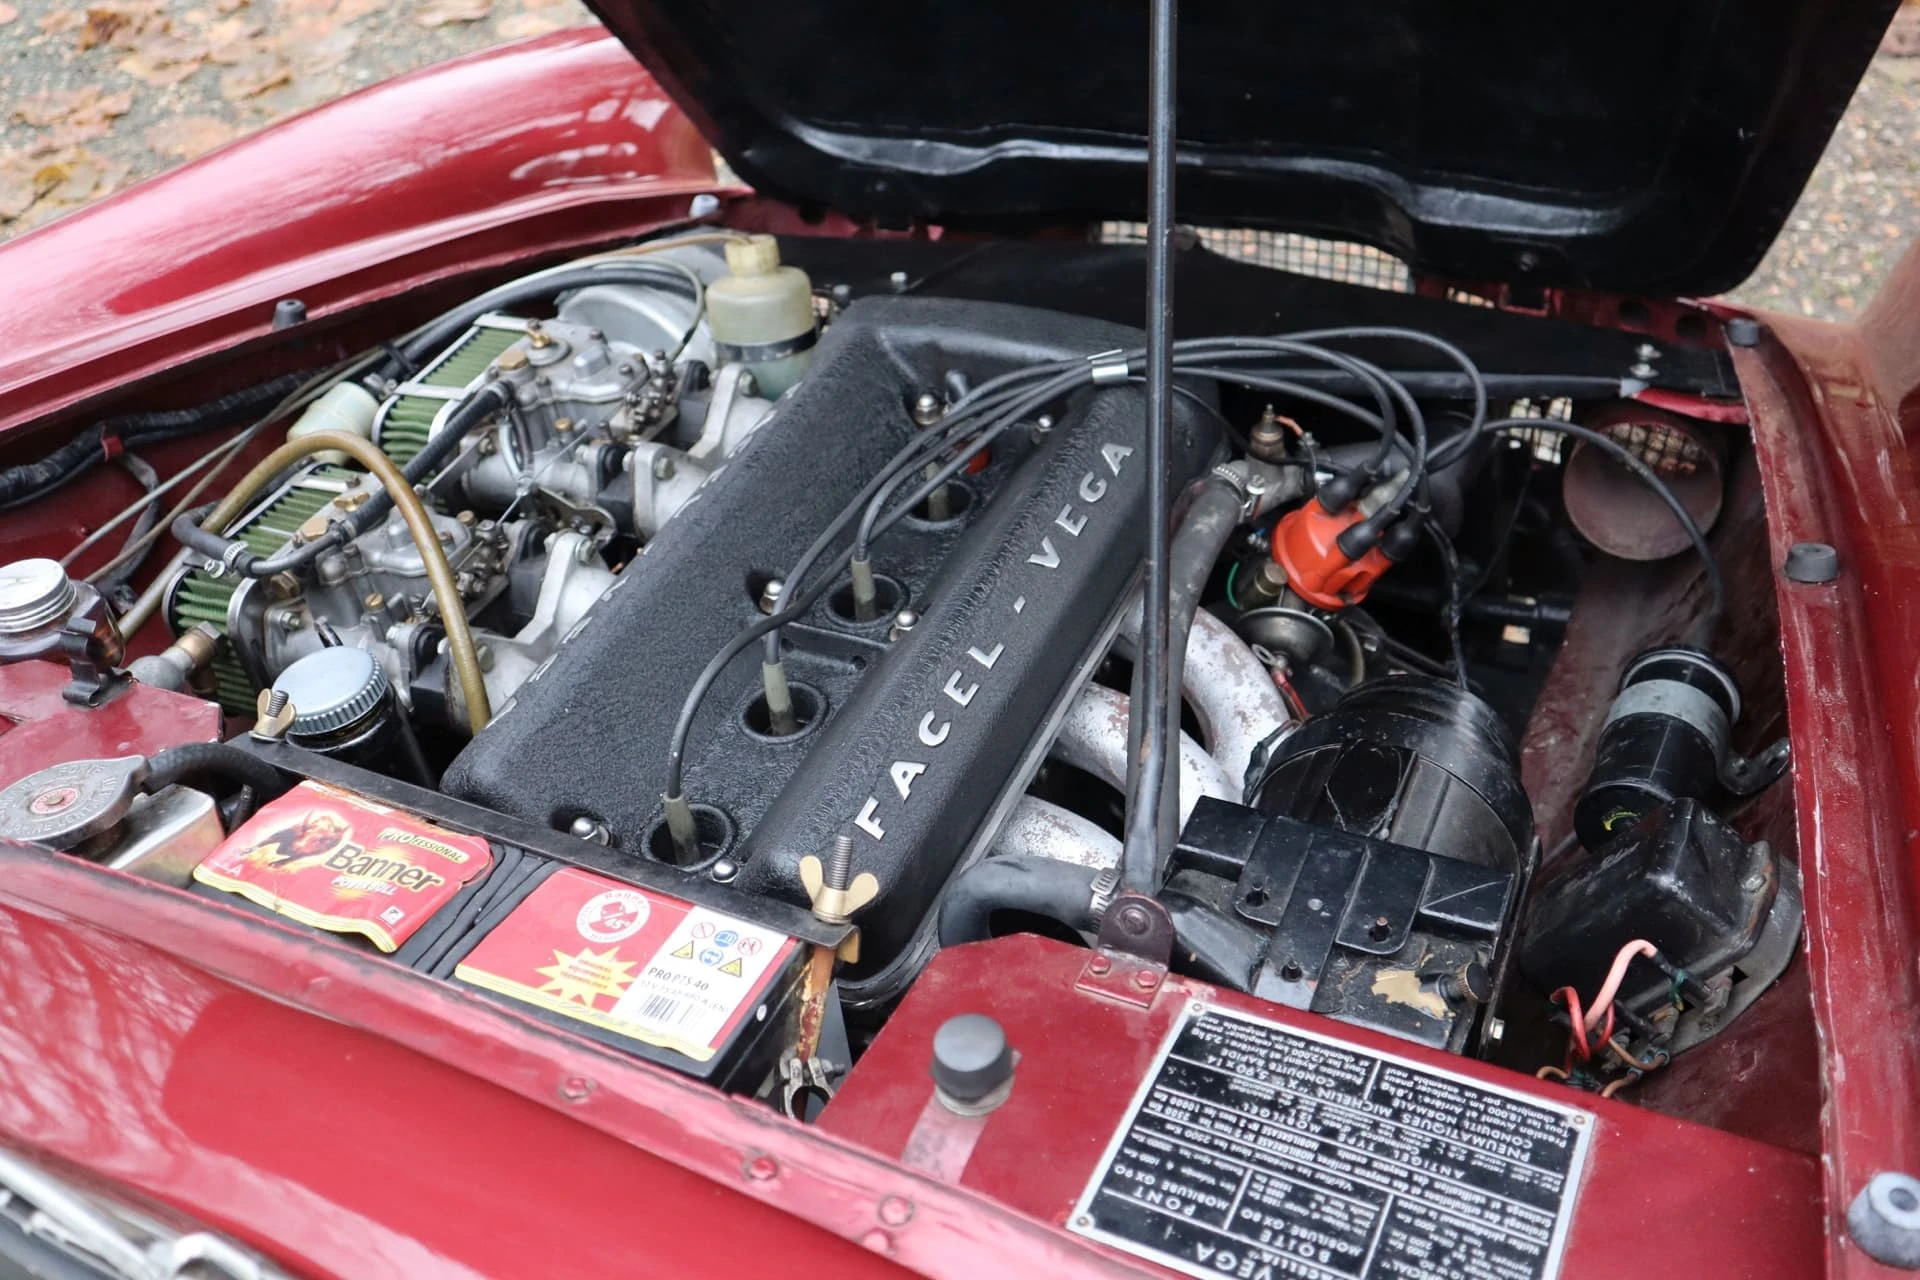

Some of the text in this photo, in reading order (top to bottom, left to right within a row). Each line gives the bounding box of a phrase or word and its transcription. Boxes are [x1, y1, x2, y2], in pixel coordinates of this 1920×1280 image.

[853, 643, 1005, 841] FACEL
[1027, 442, 1135, 569] VEGA
[378, 828, 463, 862] PROFESSIONAL
[326, 843, 443, 892] Banner
[648, 967, 672, 981] PRO
[1224, 1027, 1273, 1048] remplacer
[1268, 1050, 1281, 1060] et
[1273, 1042, 1289, 1052] km
[1308, 1043, 1355, 1063] chambres
[1205, 1054, 1223, 1066] 14
[1219, 1046, 1336, 1088] CONDUITE RAPIDE
[1281, 1053, 1317, 1072] Avant
[1325, 1056, 1342, 1068] les
[1342, 1061, 1366, 1075] Tous
[1358, 1058, 1370, 1068] et
[1234, 1062, 1269, 1080] 5,90
[1316, 1064, 1363, 1085] Pression
[1384, 1066, 1408, 1079] neuf
[1382, 1072, 1414, 1088] pneus
[1411, 1074, 1459, 1095] ensemble
[1151, 1090, 1169, 1102] Km
[1415, 1082, 1466, 1105] remplacer
[1463, 1089, 1477, 1099] un
[1481, 1094, 1501, 1107] par
[1146, 1100, 1164, 1112] Km
[1315, 1086, 1392, 1118] MICHELIN
[1468, 1099, 1484, 1111] km
[1162, 1105, 1191, 1121] 2500
[1200, 1106, 1217, 1117] les
[1216, 1110, 1238, 1123] tous
[1239, 1101, 1321, 1134] MOBILGEL
[1390, 1097, 1457, 1125] NORMALE
[1464, 1109, 1477, 1120] et
[1504, 1102, 1555, 1124] chambres
[1162, 1121, 1183, 1134] Km
[1479, 1114, 1516, 1132] Avant
[1525, 1117, 1541, 1128] les
[1544, 1122, 1570, 1137] Tous
[1128, 1131, 1146, 1143] Km
[1182, 1127, 1212, 1144] 2500
[1260, 1124, 1320, 1150] MOBILGREASE
[1336, 1132, 1375, 1151] TYPE
[1357, 1129, 1420, 1155] Contenance
[1399, 1112, 1531, 1162] PNEUMATIQUES
[1461, 1119, 1533, 1149] CONDUITE
[1518, 1125, 1566, 1148] Pression
[1211, 1137, 1229, 1150] les
[1228, 1142, 1253, 1158] tous
[1255, 1135, 1316, 1161] MOBILGREASE
[1121, 1146, 1139, 1158] Km
[1112, 1162, 1135, 1178] 90
[1294, 1164, 1312, 1177] les
[1390, 1149, 1464, 1180] ANTIGEL
[1133, 1170, 1157, 1185] GX
[1313, 1170, 1355, 1191] Vérifier
[1390, 1178, 1409, 1192] des
[1411, 1172, 1429, 1186] des
[1159, 1179, 1230, 1211] MOBILUBE
[1409, 1184, 1421, 1196] et
[1432, 1180, 1486, 1206] vérification
[1132, 1184, 1196, 1216] PONT
[1490, 1198, 1501, 1210] et
[1395, 1211, 1412, 1223] Km
[1482, 1210, 1501, 1224] des
[1504, 1202, 1552, 1228] Graissage
[1238, 1206, 1363, 1258] MOBILUBE GX 80
[1390, 1228, 1407, 1241] Km
[1502, 1215, 1550, 1240] Graissage
[1387, 1238, 1404, 1250] Km
[1190, 1241, 1275, 1280] VEGA
